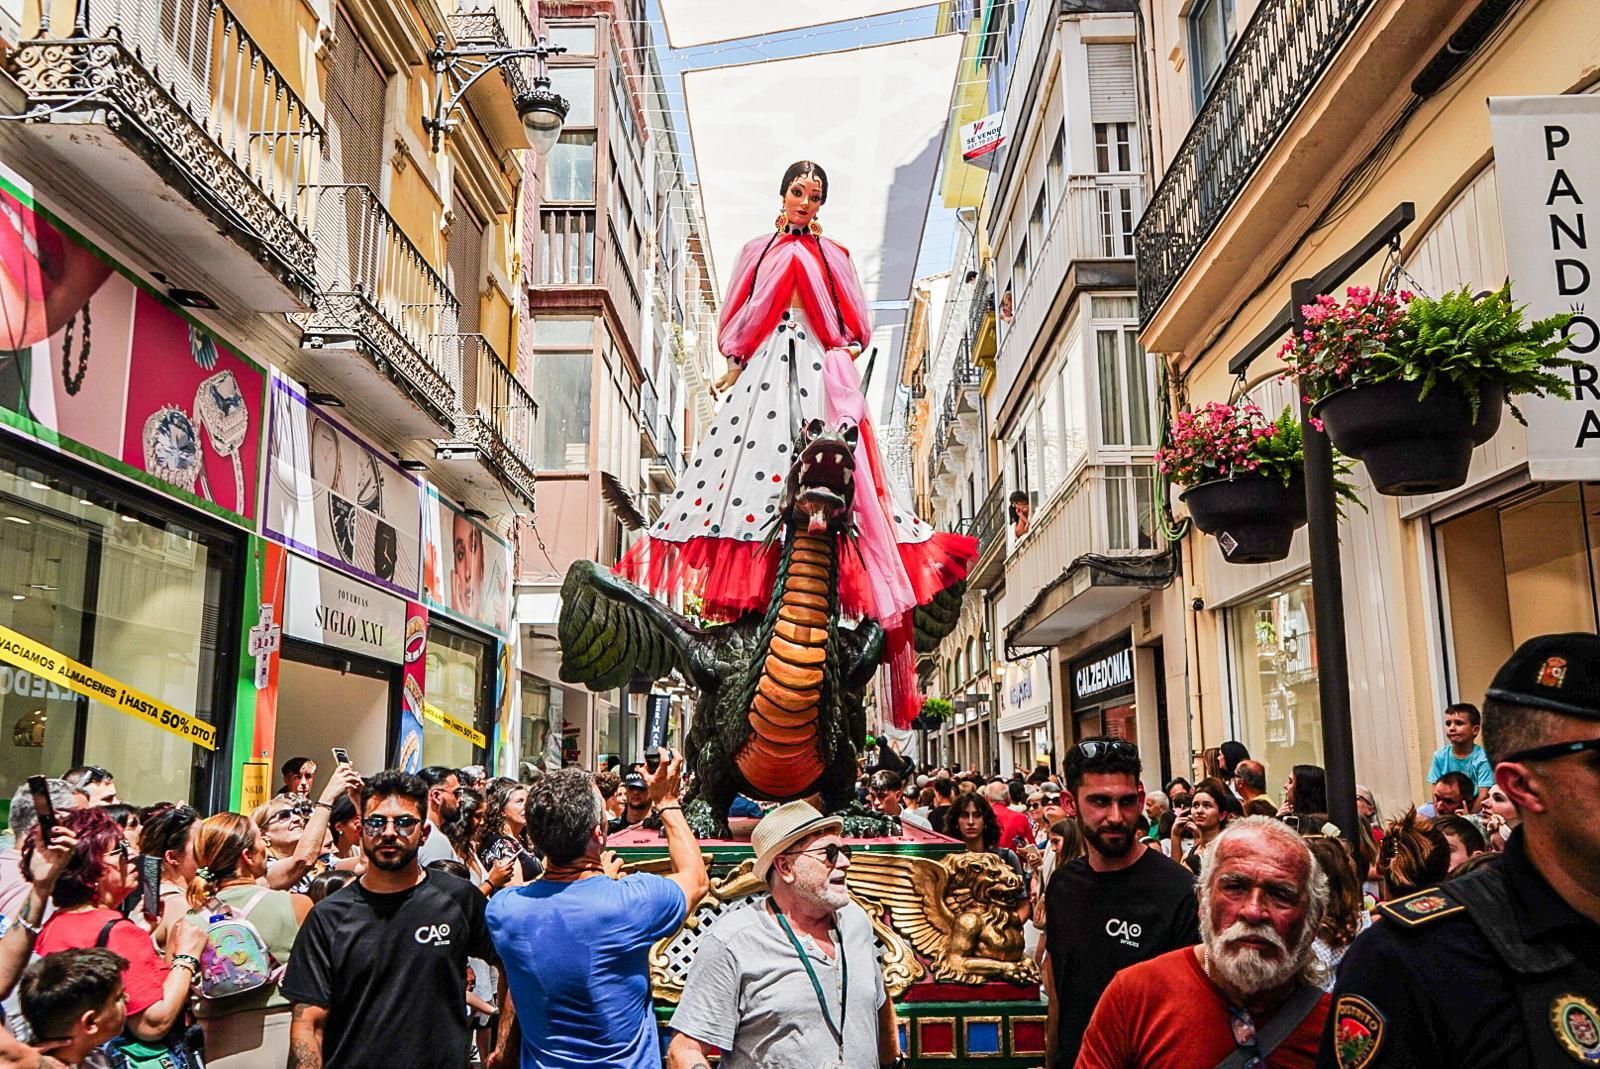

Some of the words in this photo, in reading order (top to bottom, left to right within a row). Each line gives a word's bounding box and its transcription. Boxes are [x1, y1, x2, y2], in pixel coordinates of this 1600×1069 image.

[966, 137, 976, 145] SE
[977, 127, 1001, 140] VENDE
[1544, 125, 1600, 448] PANDORA
[315, 604, 356, 638] SIGLO
[360, 619, 384, 646] XXI
[1076, 648, 1132, 698] CALZEDONIA
[58, 665, 117, 698] ALMACENES
[119, 690, 158, 718] ¡HASTA
[160, 709, 189, 734] 50%
[415, 924, 450, 944] CAO
[1106, 918, 1142, 940] CAO
